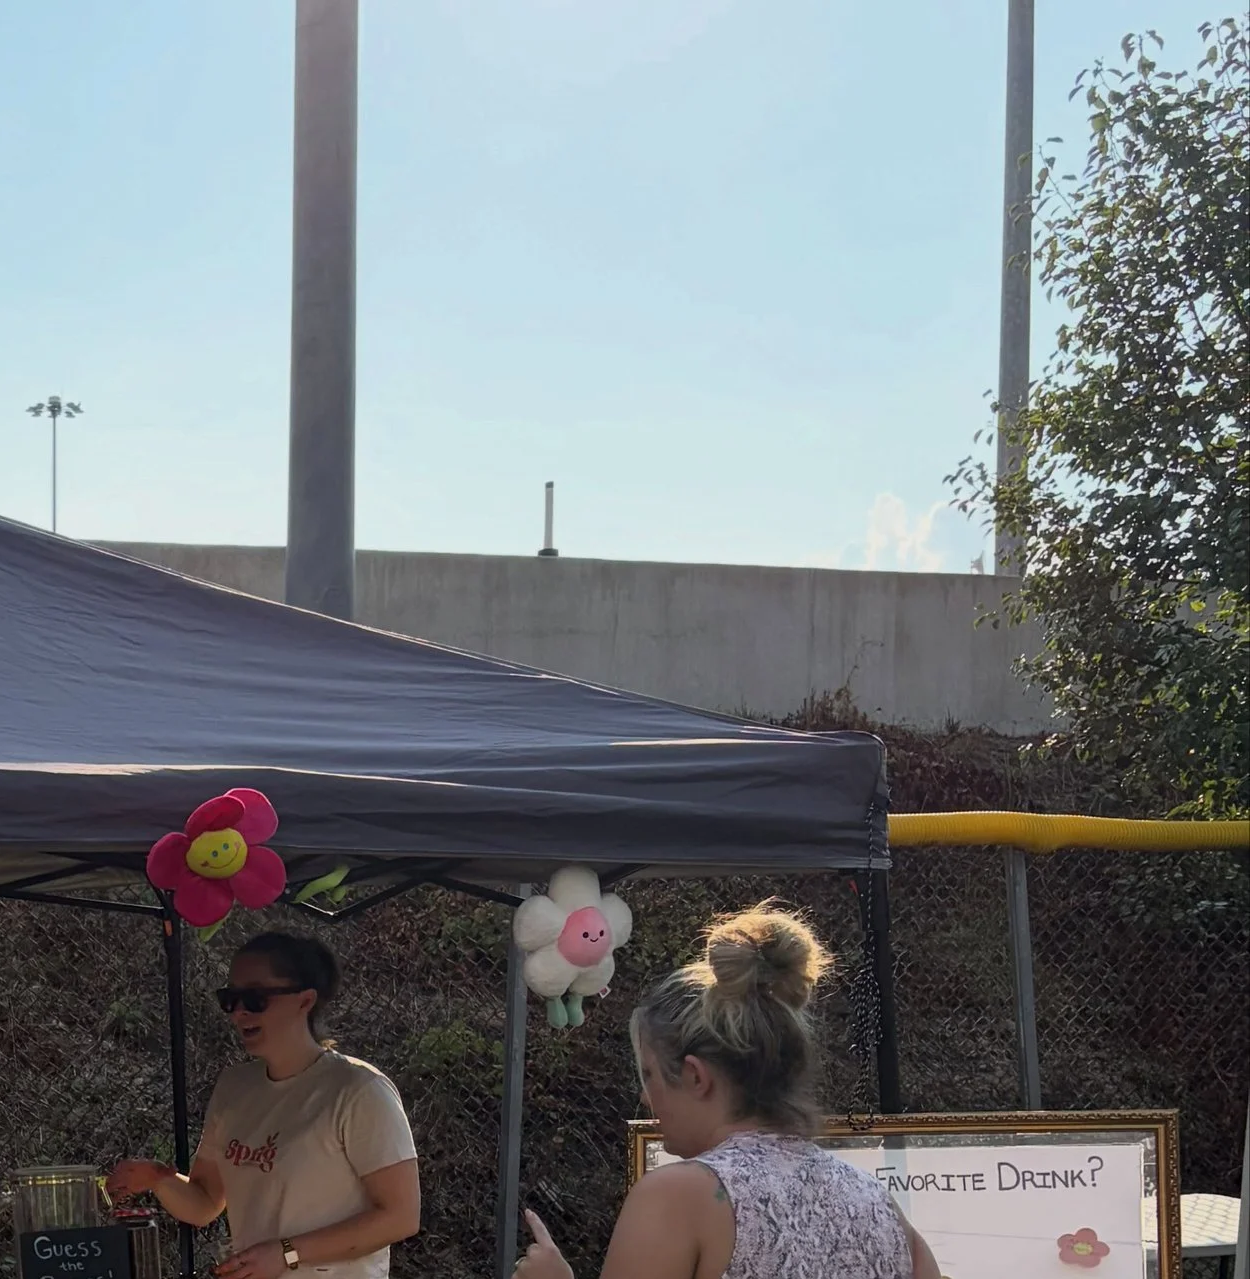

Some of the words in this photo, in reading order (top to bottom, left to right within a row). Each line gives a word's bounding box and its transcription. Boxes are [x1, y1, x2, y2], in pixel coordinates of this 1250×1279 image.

[875, 1166, 986, 1191] FAVORITE
[997, 1156, 1104, 1191] DRINK?
[34, 1235, 102, 1259] Guess
[59, 1261, 85, 1271] the
